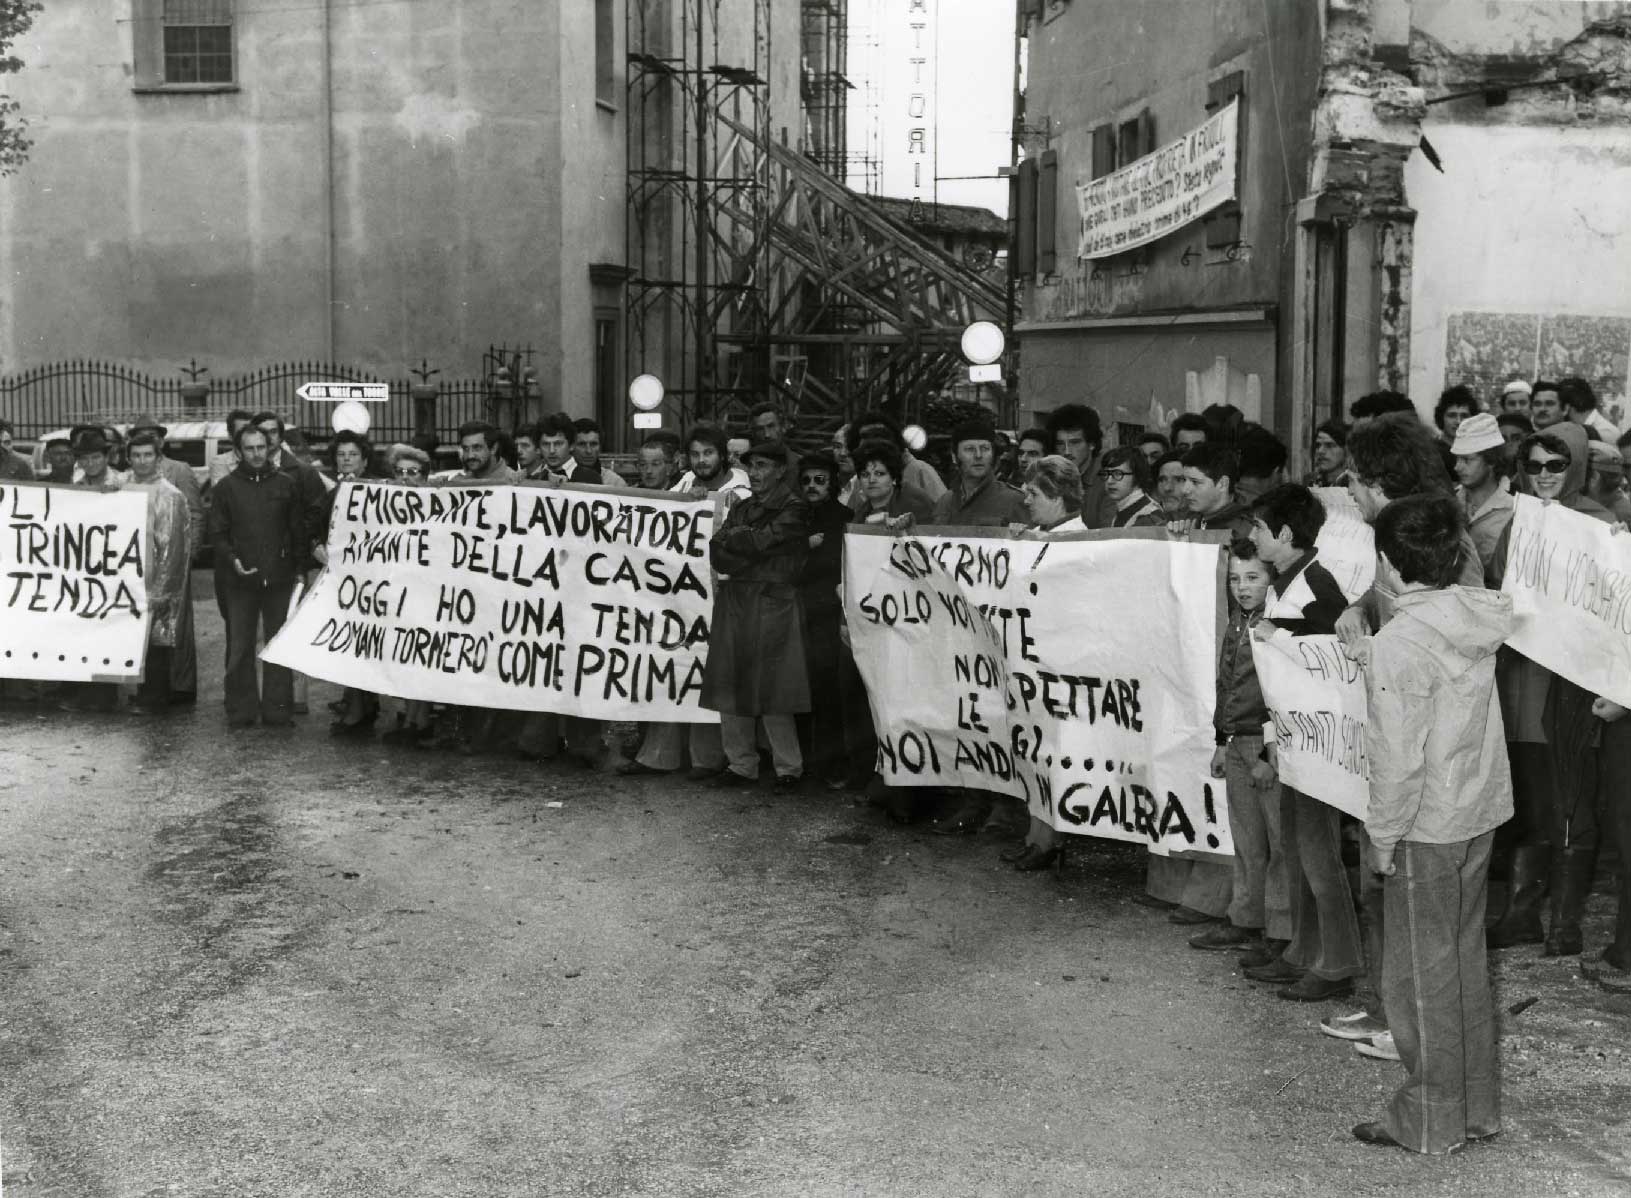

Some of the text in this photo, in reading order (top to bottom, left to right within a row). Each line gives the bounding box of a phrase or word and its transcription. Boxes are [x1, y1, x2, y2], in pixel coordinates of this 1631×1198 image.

[9, 522, 144, 578] TRINCEA
[510, 491, 714, 558] LAVORATORE
[342, 529, 709, 600] AMANTE DELLA CASA
[7, 571, 141, 620] TENDA
[337, 574, 711, 652] OGGI HO UNA TENDA
[859, 590, 932, 627] SOLO
[311, 617, 387, 661] DOMANI
[498, 640, 567, 692] COME
[573, 643, 705, 706] PRIMA
[876, 729, 941, 775] NOI
